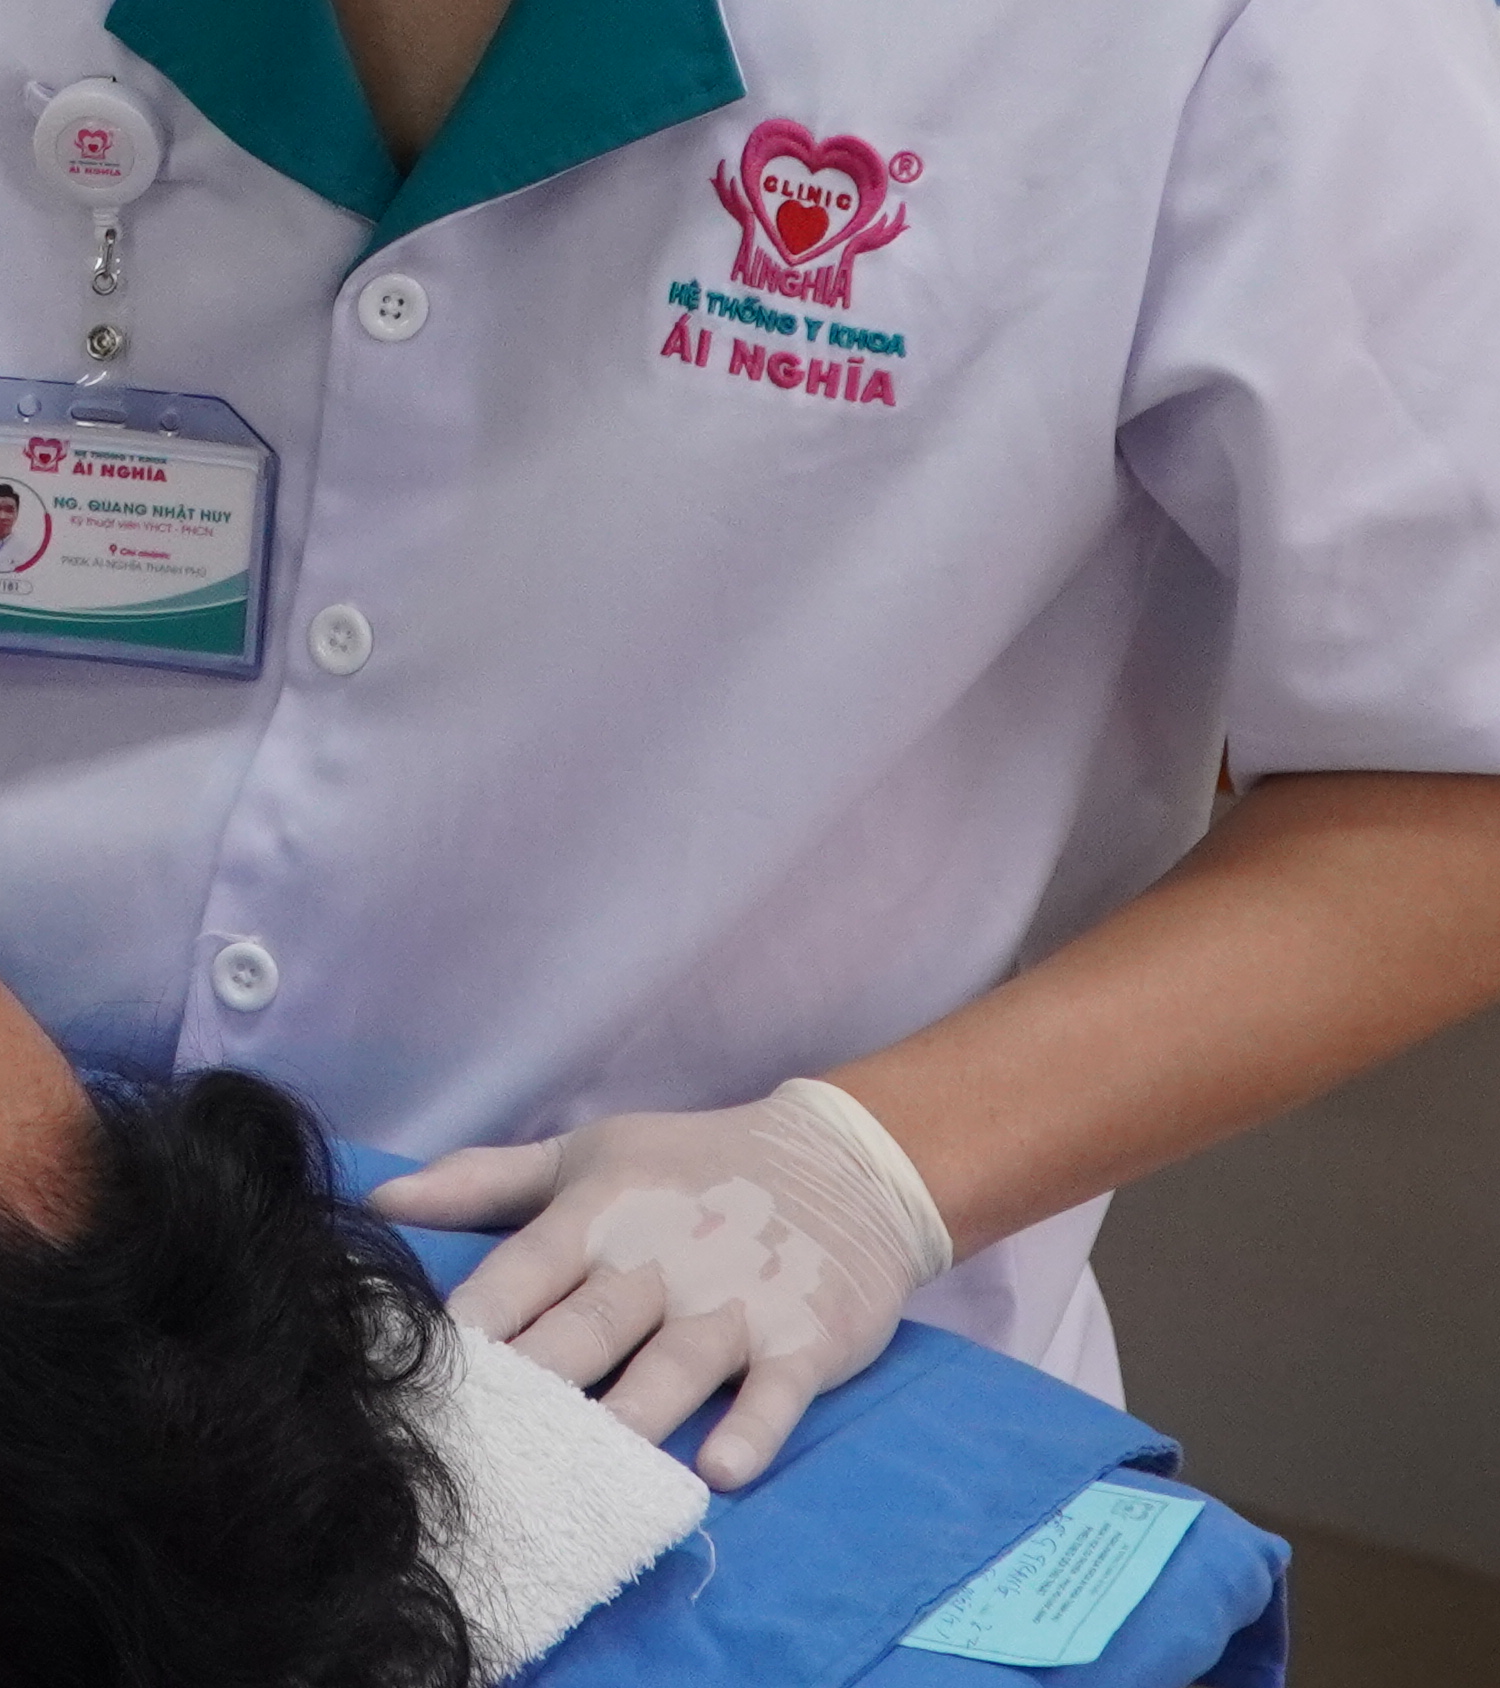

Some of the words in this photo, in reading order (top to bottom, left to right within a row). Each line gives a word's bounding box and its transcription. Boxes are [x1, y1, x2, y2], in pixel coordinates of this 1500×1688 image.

[763, 175, 853, 211] CLINIC
[668, 278, 701, 312] HỆ
[706, 290, 798, 336] THỐNG
[804, 317, 824, 342] Y
[829, 322, 907, 358] KHOA
[660, 313, 713, 368] ÁI
[729, 337, 896, 407] NGHĨA
[73, 460, 92, 476] ÁI
[54, 497, 82, 511] NG.
[88, 499, 147, 516] QUANG
[153, 503, 195, 523] NHẬT
[200, 509, 232, 524] HUY
